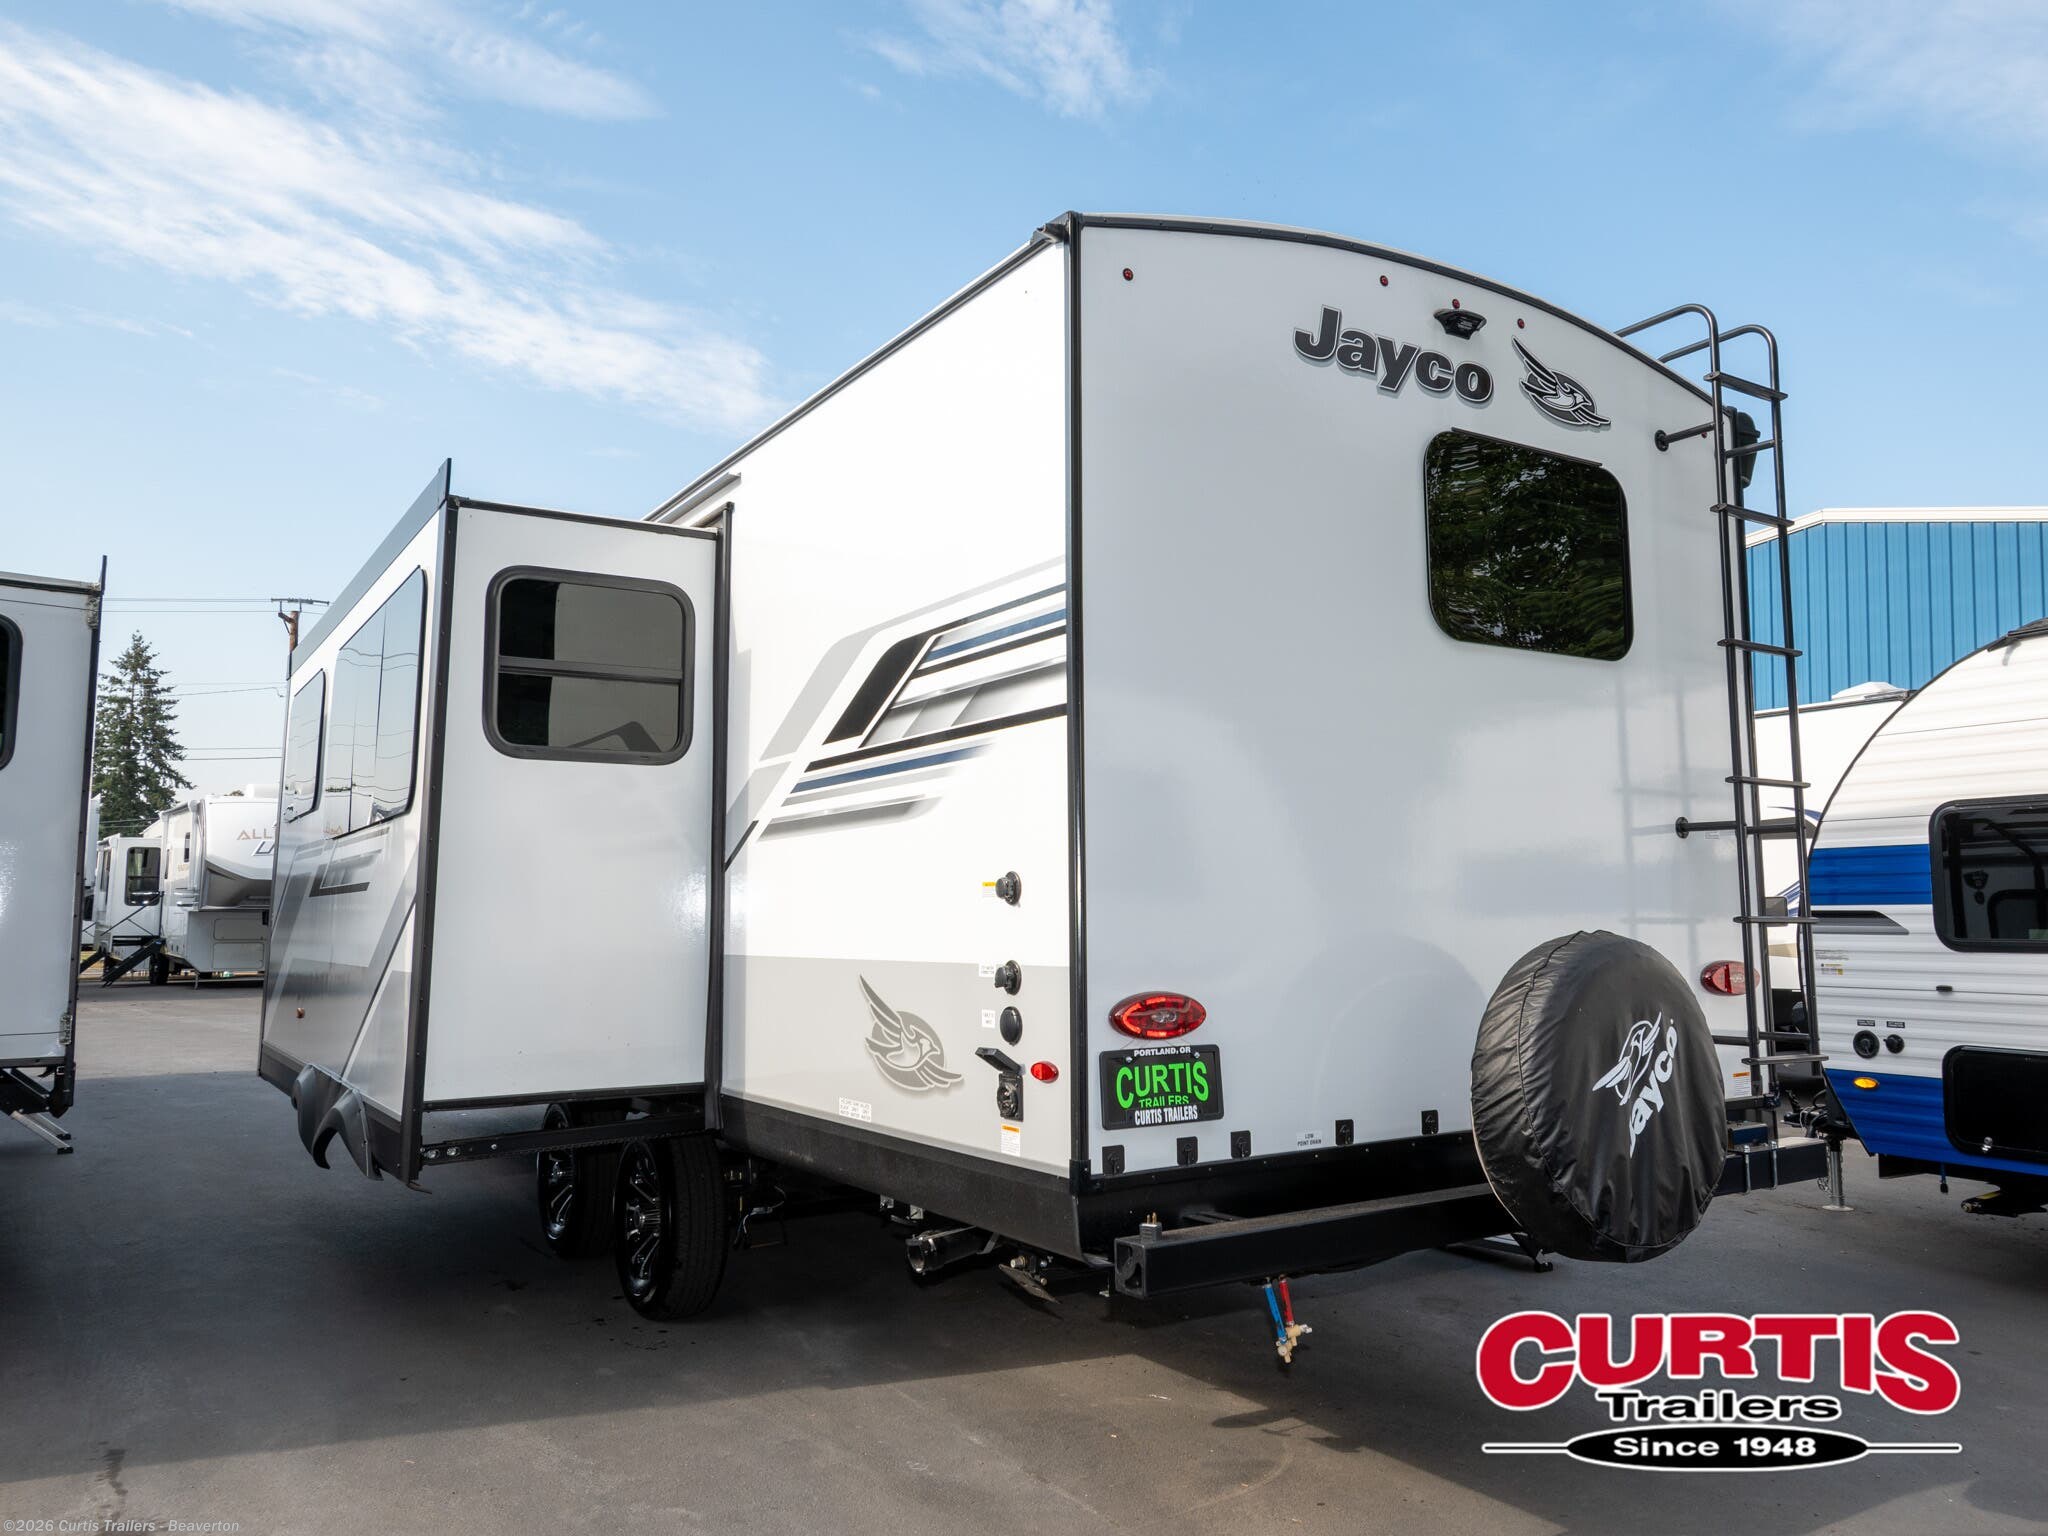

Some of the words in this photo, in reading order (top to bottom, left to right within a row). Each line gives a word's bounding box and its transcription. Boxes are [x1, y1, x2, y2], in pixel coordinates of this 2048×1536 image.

[1293, 304, 1493, 403] Jayco
[1134, 1046, 1179, 1057] PORTLAND,
[1180, 1046, 1191, 1054] OR
[1116, 1060, 1209, 1109] CURTIS
[1134, 1108, 1162, 1126] CURTIS
[1163, 1104, 1198, 1122] TRAILERS
